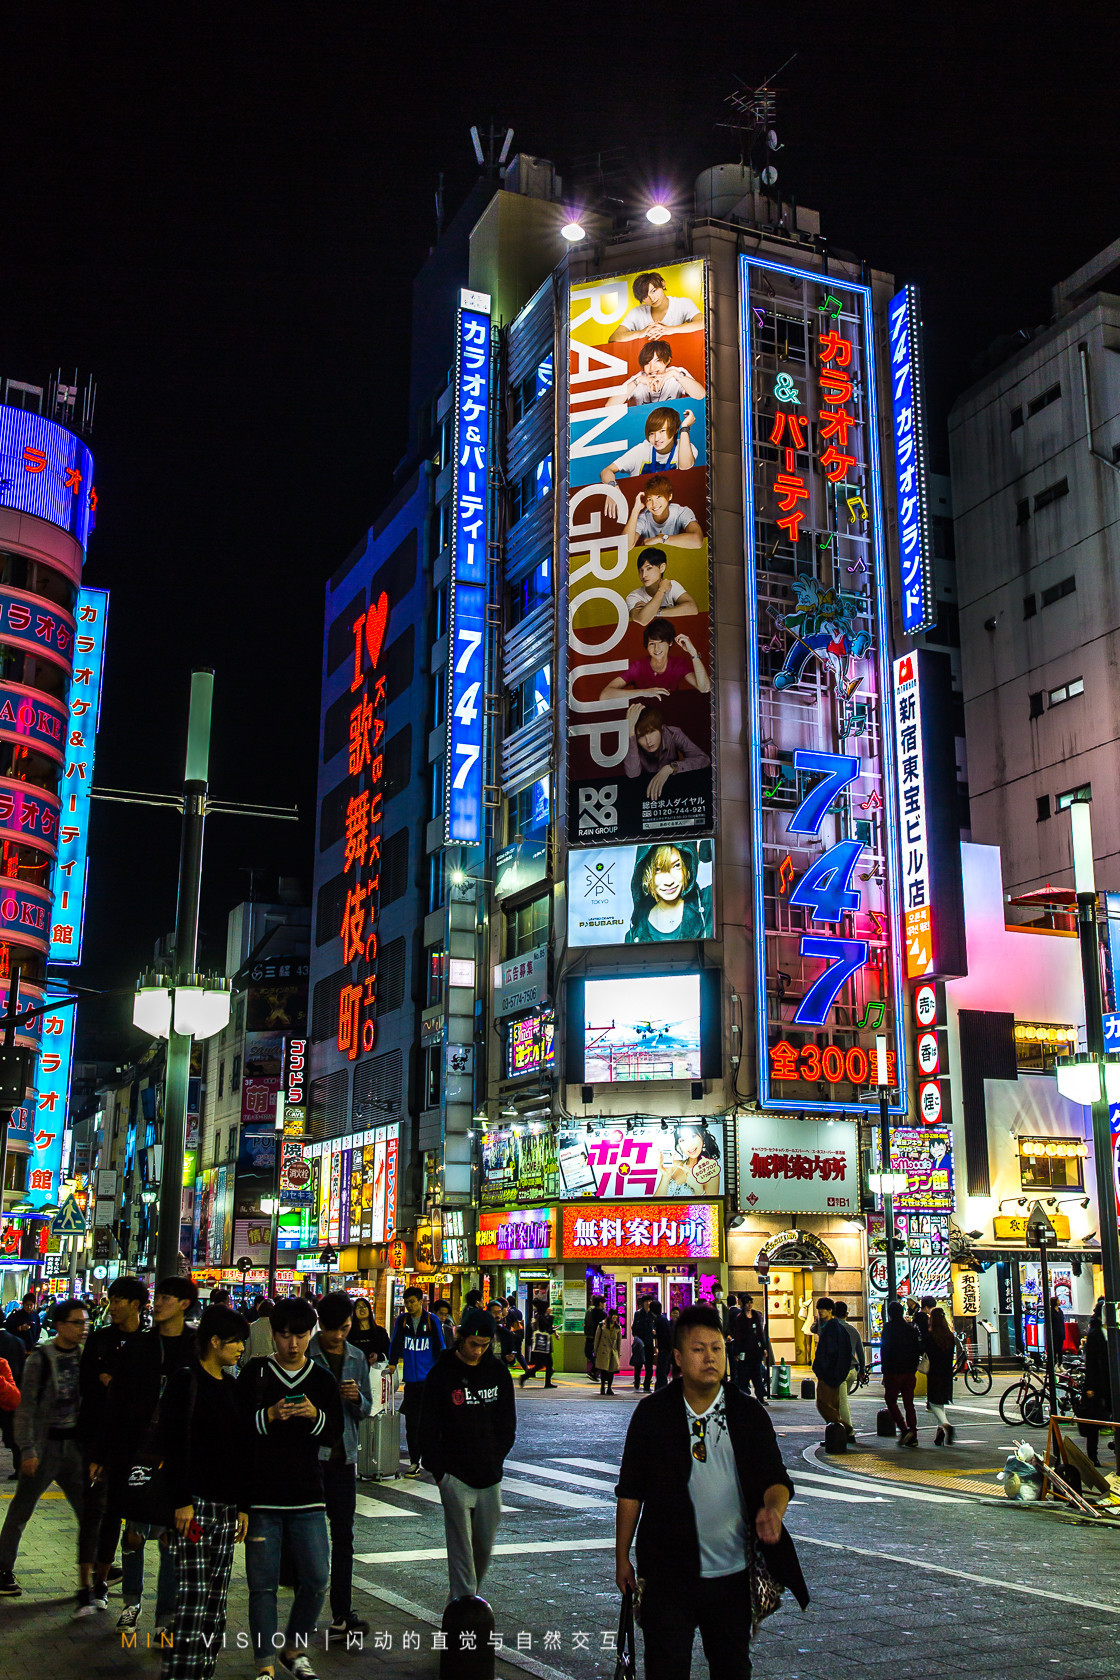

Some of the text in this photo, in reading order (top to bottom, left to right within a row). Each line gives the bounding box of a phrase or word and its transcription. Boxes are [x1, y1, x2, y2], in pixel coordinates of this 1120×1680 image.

[569, 280, 628, 459] RAIN
[818, 329, 857, 483] カラオケ
[458, 319, 487, 566] カラオケ&パーティー
[890, 303, 924, 619] 747 カラオケランド
[769, 411, 810, 543] パーティ
[568, 482, 630, 769] GROUP
[452, 630, 483, 790] 747
[52, 604, 98, 944] カラオケ&パーティー館
[642, 797, 706, 810] 総合求人ダイヤル
[653, 806, 706, 816] 0120-744-921
[899, 692, 926, 909] 新宿東宝ビル店
[578, 826, 618, 836] RAIN GROUP
[337, 692, 373, 1061] 歌舞伎町
[786, 747, 871, 1027] 747
[504, 960, 534, 985] 広告募集
[501, 986, 538, 1012] 03-5774-7506
[289, 1039, 307, 1103] ゴンドラ
[31, 1015, 64, 1190] カラオケ館
[246, 1084, 270, 1113] 萌
[288, 1168, 310, 1179] 消火栓
[749, 1153, 848, 1181] 無料案内所
[839, 1197, 850, 1207] B1
[573, 1217, 705, 1247] 無料案内所
[918, 1271, 946, 1284] Queen
[961, 1274, 978, 1314] 和食酒処
[404, 1336, 430, 1352] ITALIA
